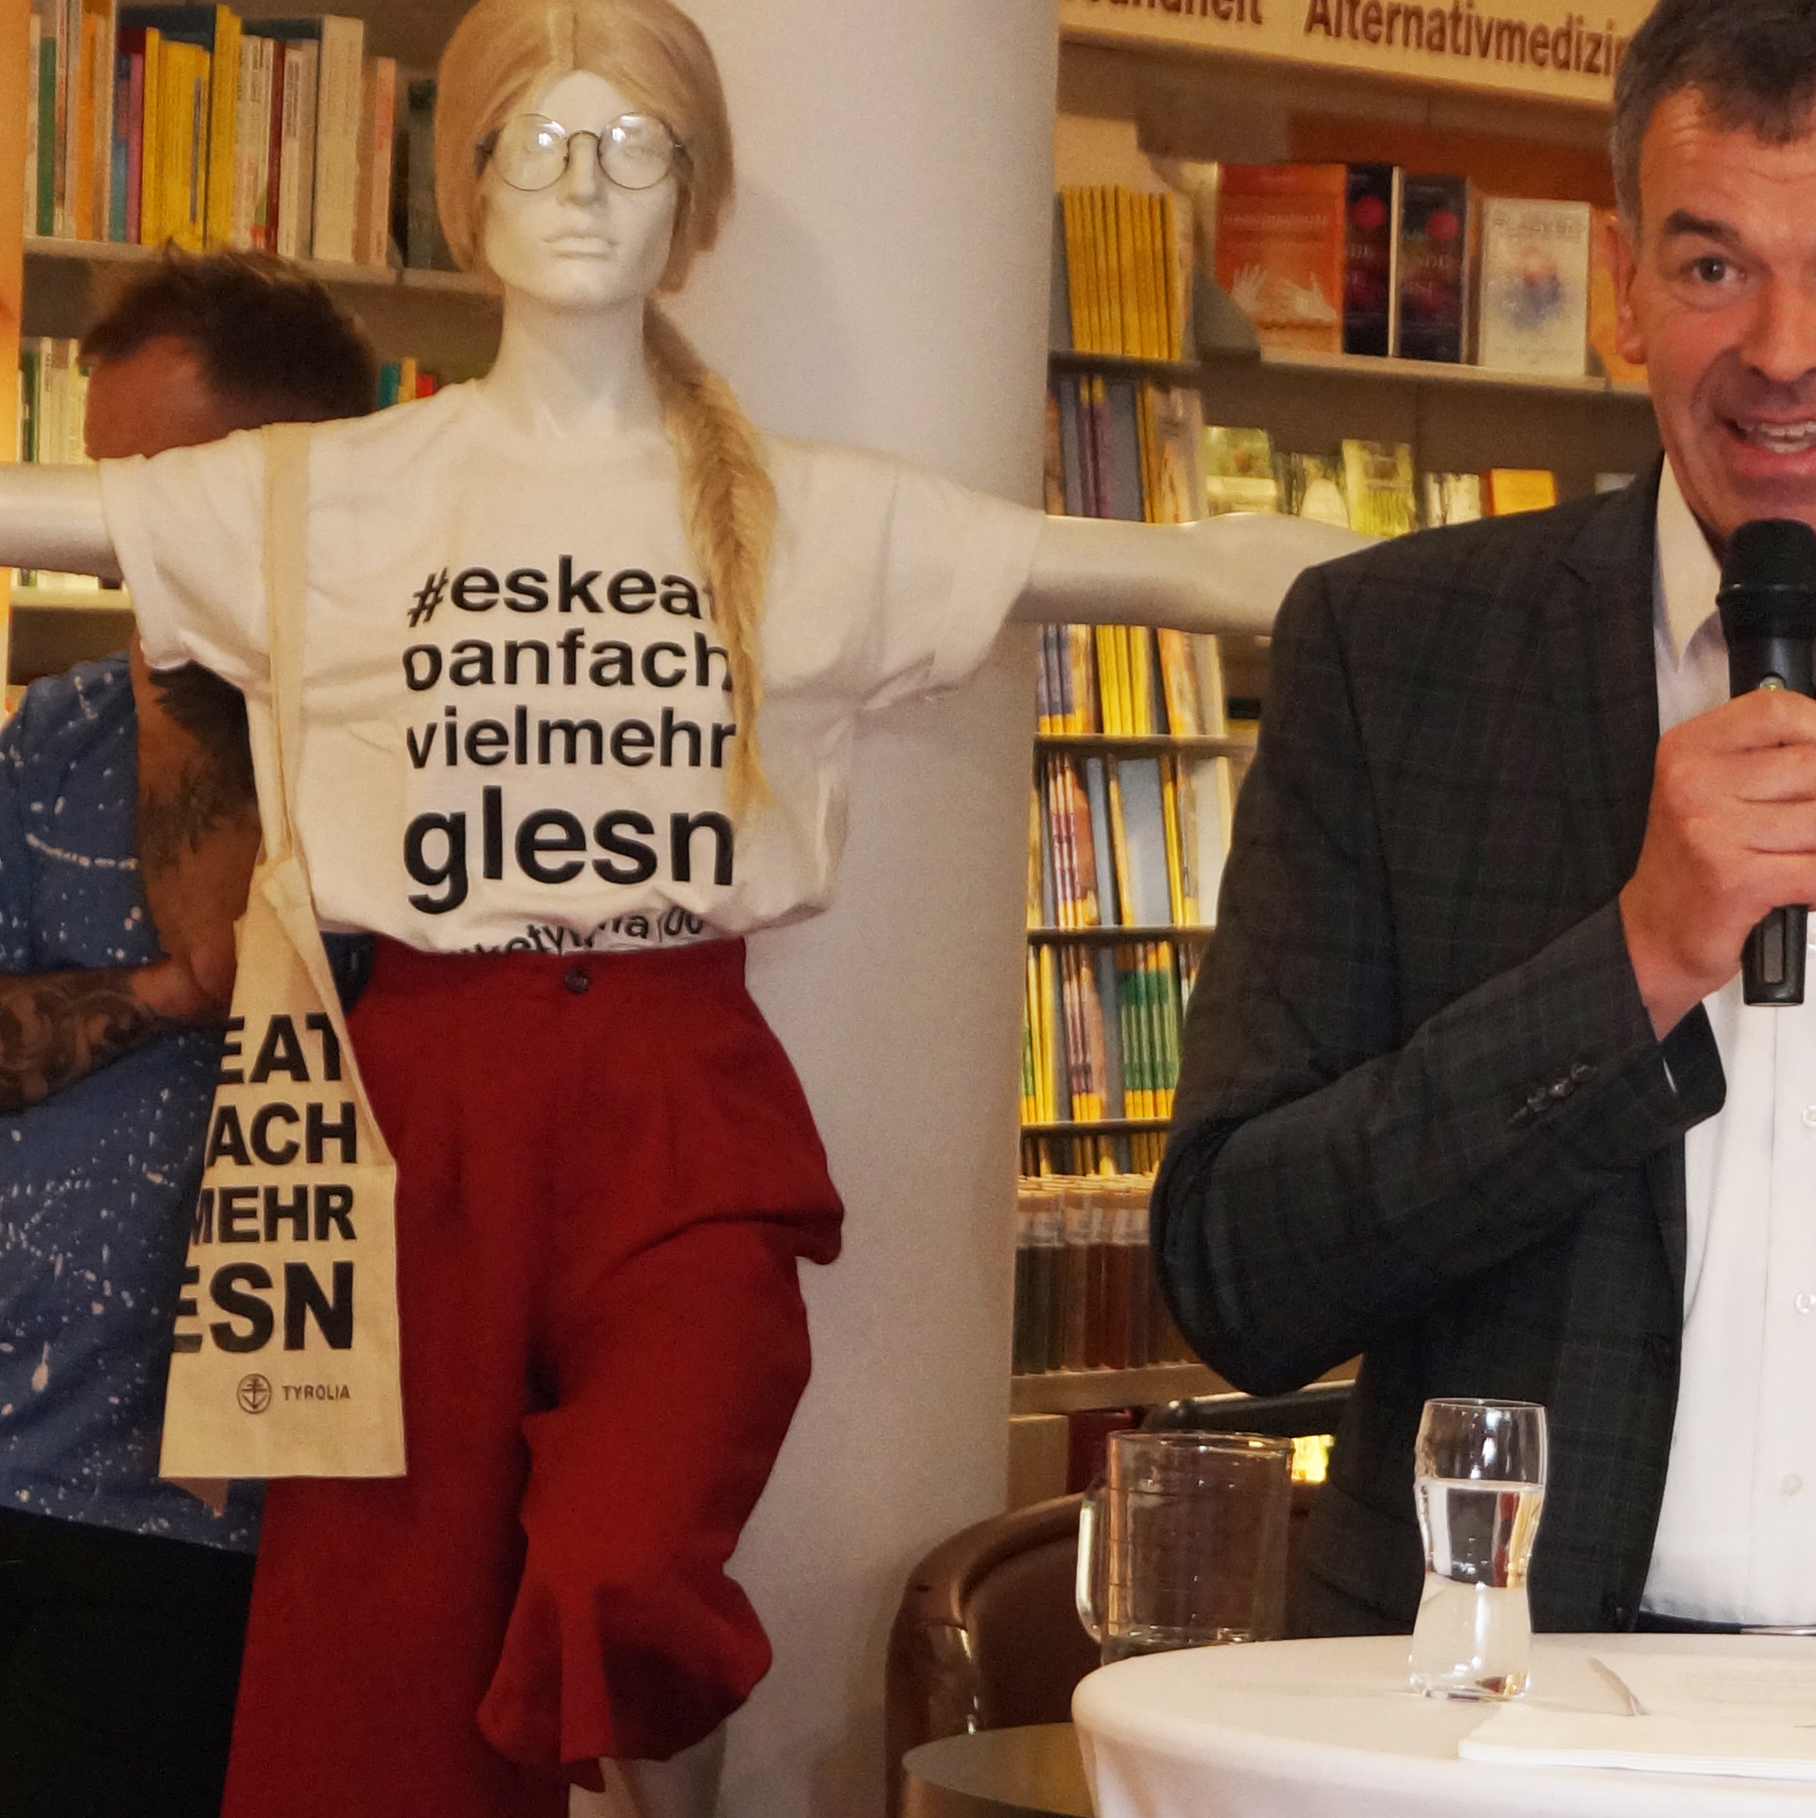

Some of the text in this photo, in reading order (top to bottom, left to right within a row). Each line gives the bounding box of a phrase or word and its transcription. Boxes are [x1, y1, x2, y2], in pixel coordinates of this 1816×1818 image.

[406, 554, 718, 628] #eskea
[405, 703, 737, 770] vielmehr
[404, 784, 735, 915] glesn
[281, 1384, 351, 1402] TYROLIA
